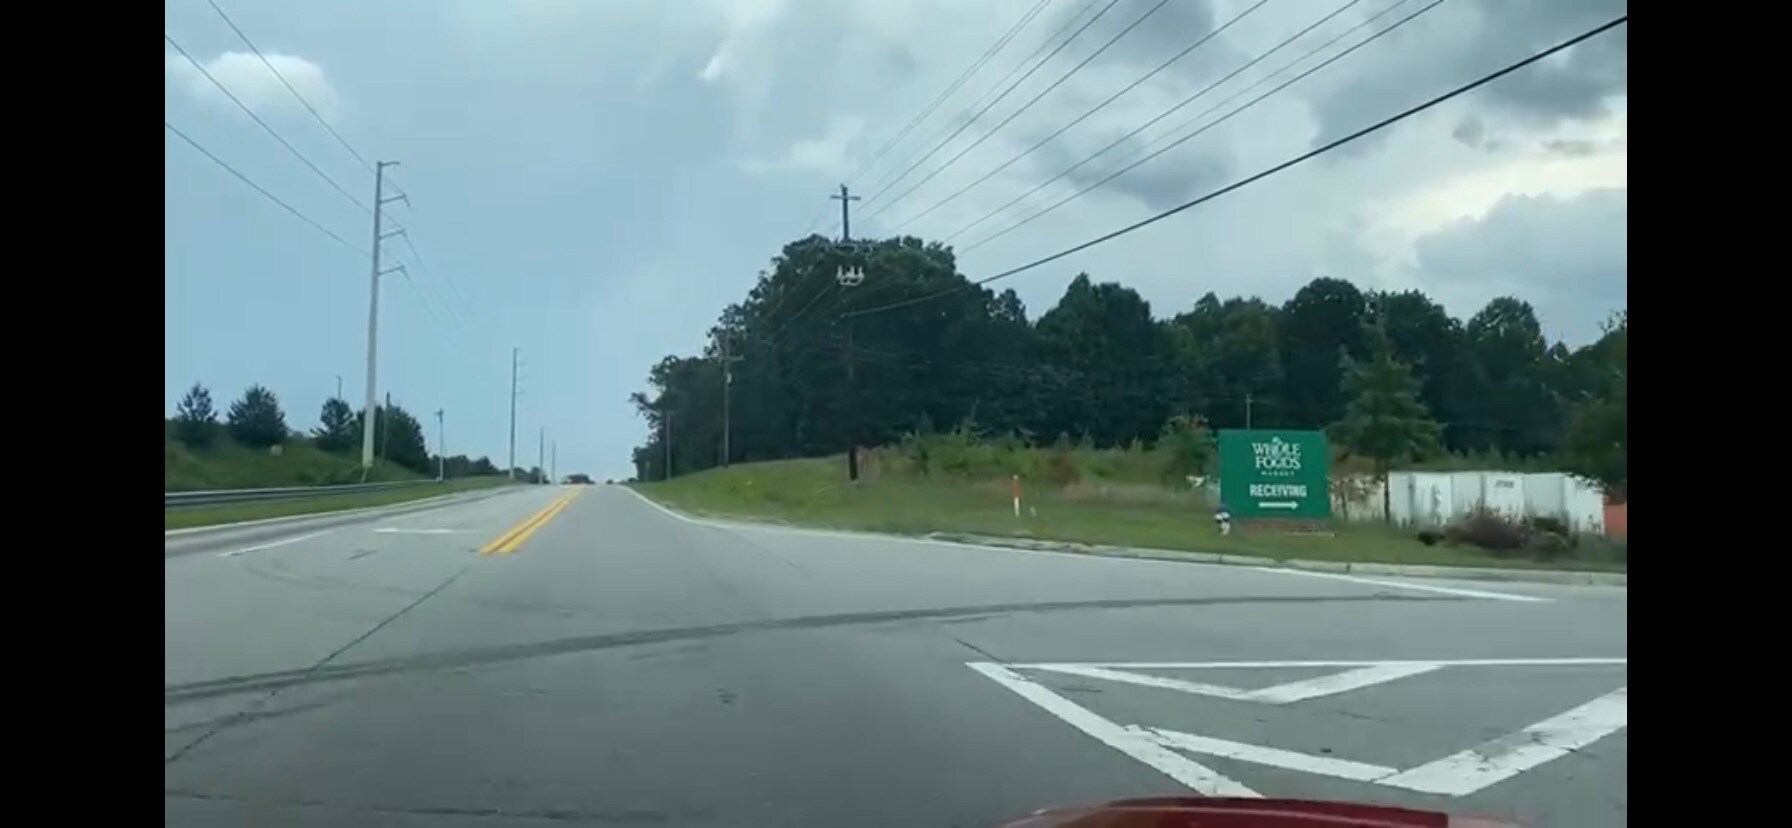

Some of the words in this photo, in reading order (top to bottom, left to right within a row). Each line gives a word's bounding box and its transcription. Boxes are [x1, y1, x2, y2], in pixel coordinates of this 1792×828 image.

[1251, 443, 1301, 456] WHOLE
[1255, 456, 1301, 469] FOODS
[1249, 484, 1308, 497] RECEIVING
